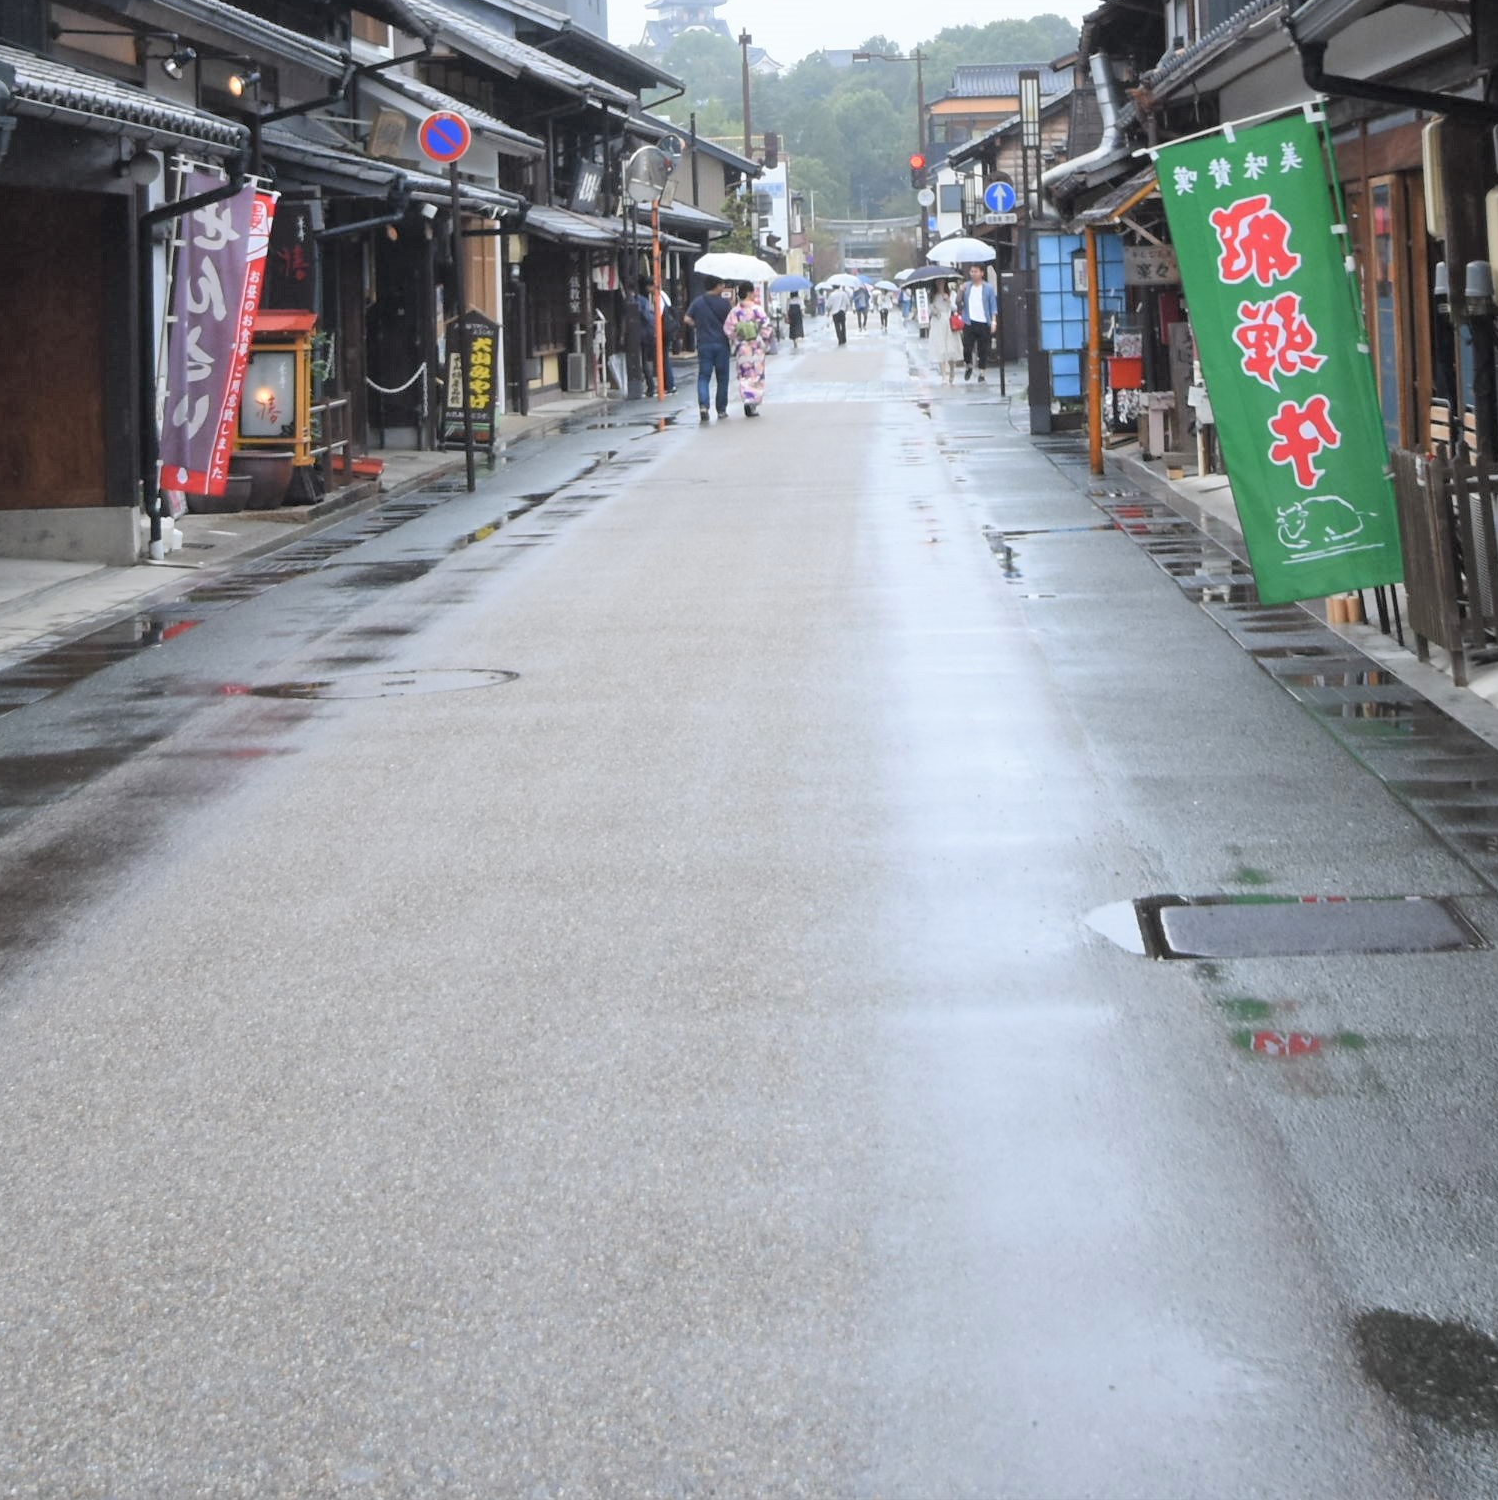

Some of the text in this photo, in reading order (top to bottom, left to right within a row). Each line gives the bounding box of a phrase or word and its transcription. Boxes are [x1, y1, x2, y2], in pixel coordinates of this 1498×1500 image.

[469, 337, 492, 409] 犬山みやげ
